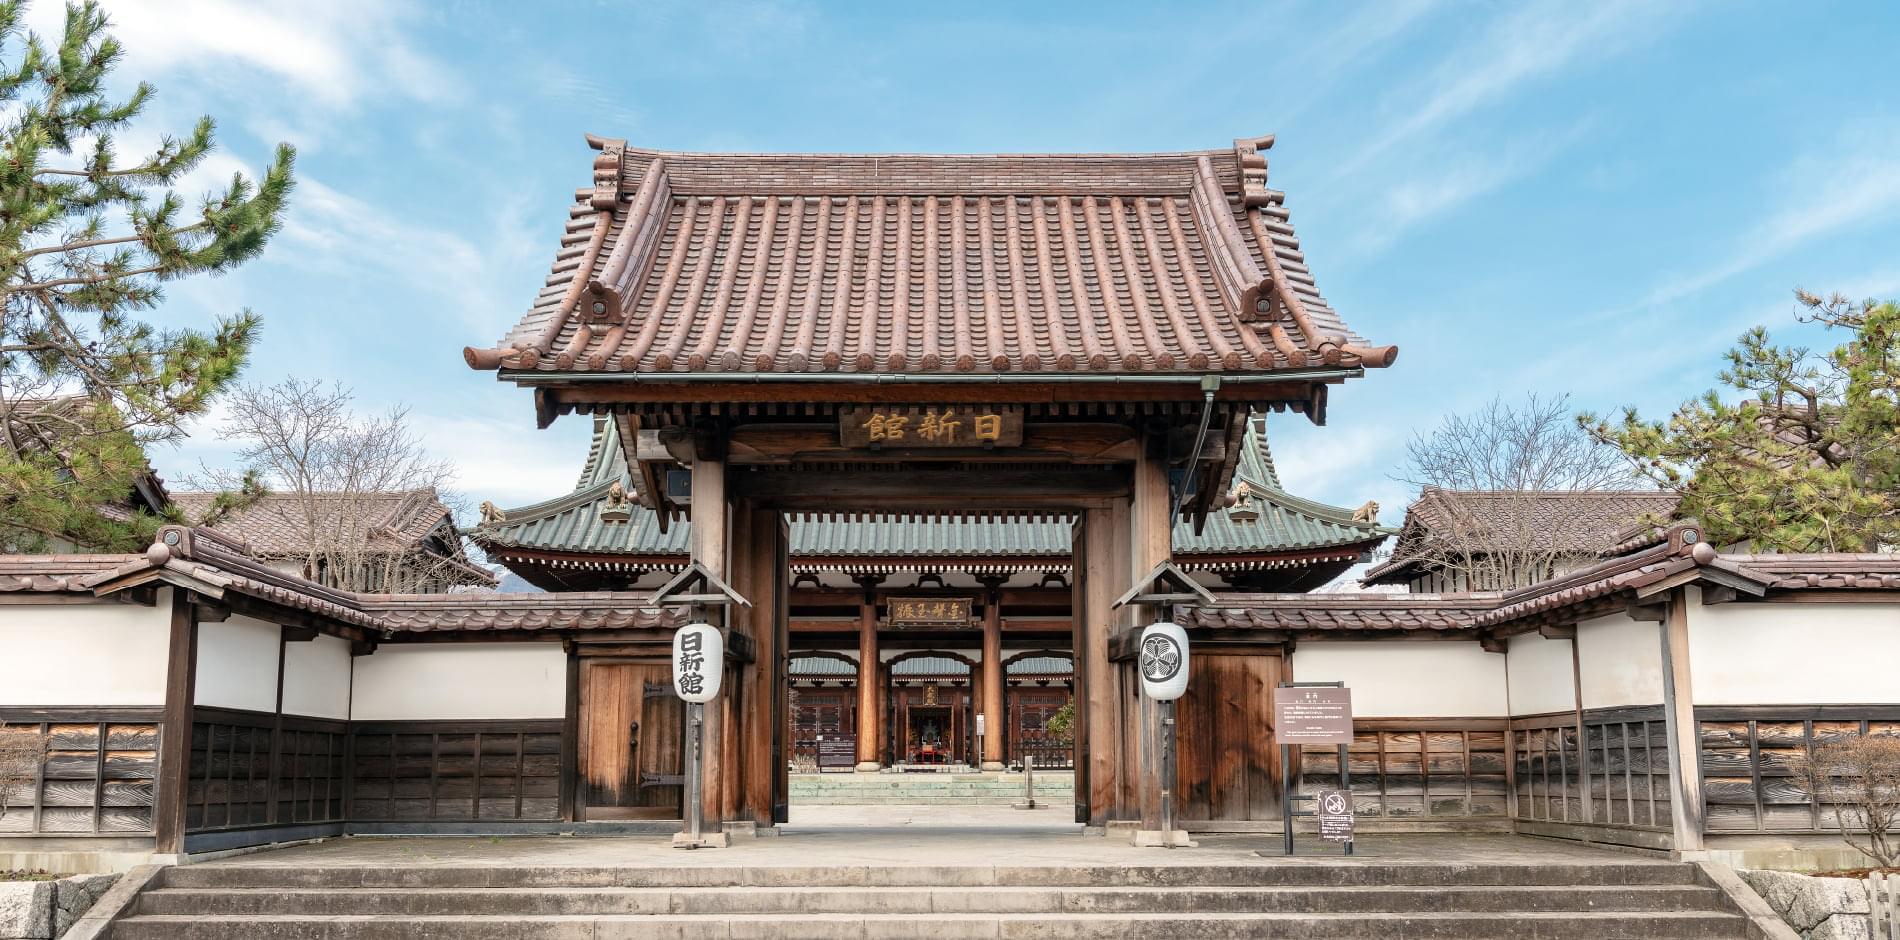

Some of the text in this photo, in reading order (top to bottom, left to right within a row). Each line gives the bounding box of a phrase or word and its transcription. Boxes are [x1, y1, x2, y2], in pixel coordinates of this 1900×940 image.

[862, 409, 1002, 444] 日新館
[678, 631, 705, 695] 日新館
